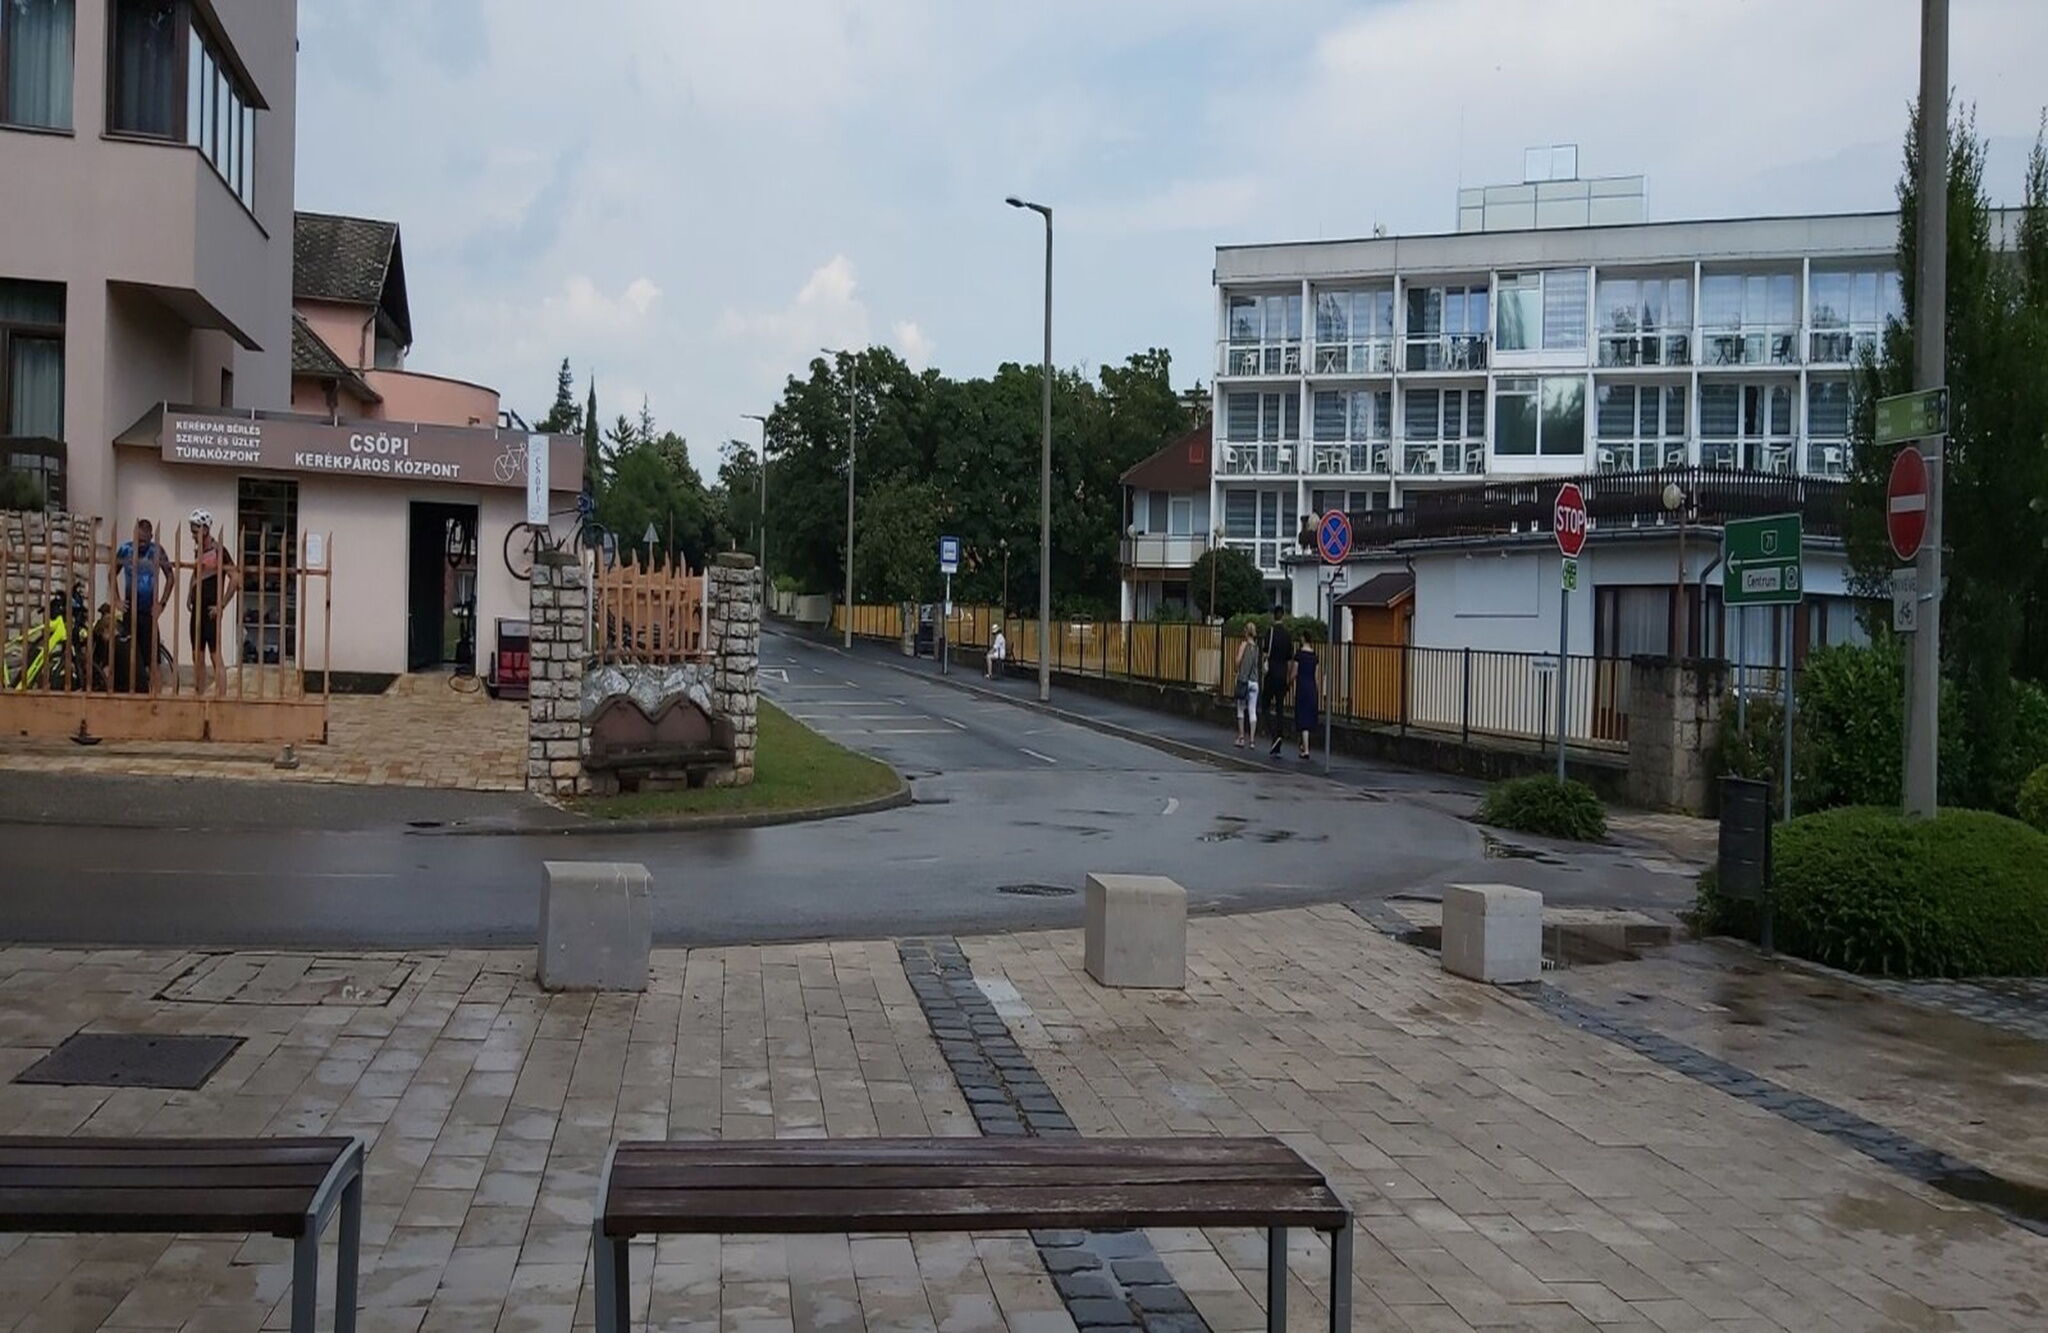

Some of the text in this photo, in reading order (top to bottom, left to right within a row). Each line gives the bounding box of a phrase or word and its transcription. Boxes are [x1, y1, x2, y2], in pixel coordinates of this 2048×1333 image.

[176, 445, 261, 462] TÚRAKÖZPONT
[350, 432, 409, 455] CSÖPI
[295, 452, 460, 477] KERÉKPÁROS KÖZPONT
[1556, 505, 1584, 535] STOP
[1747, 573, 1777, 588] Centrum
